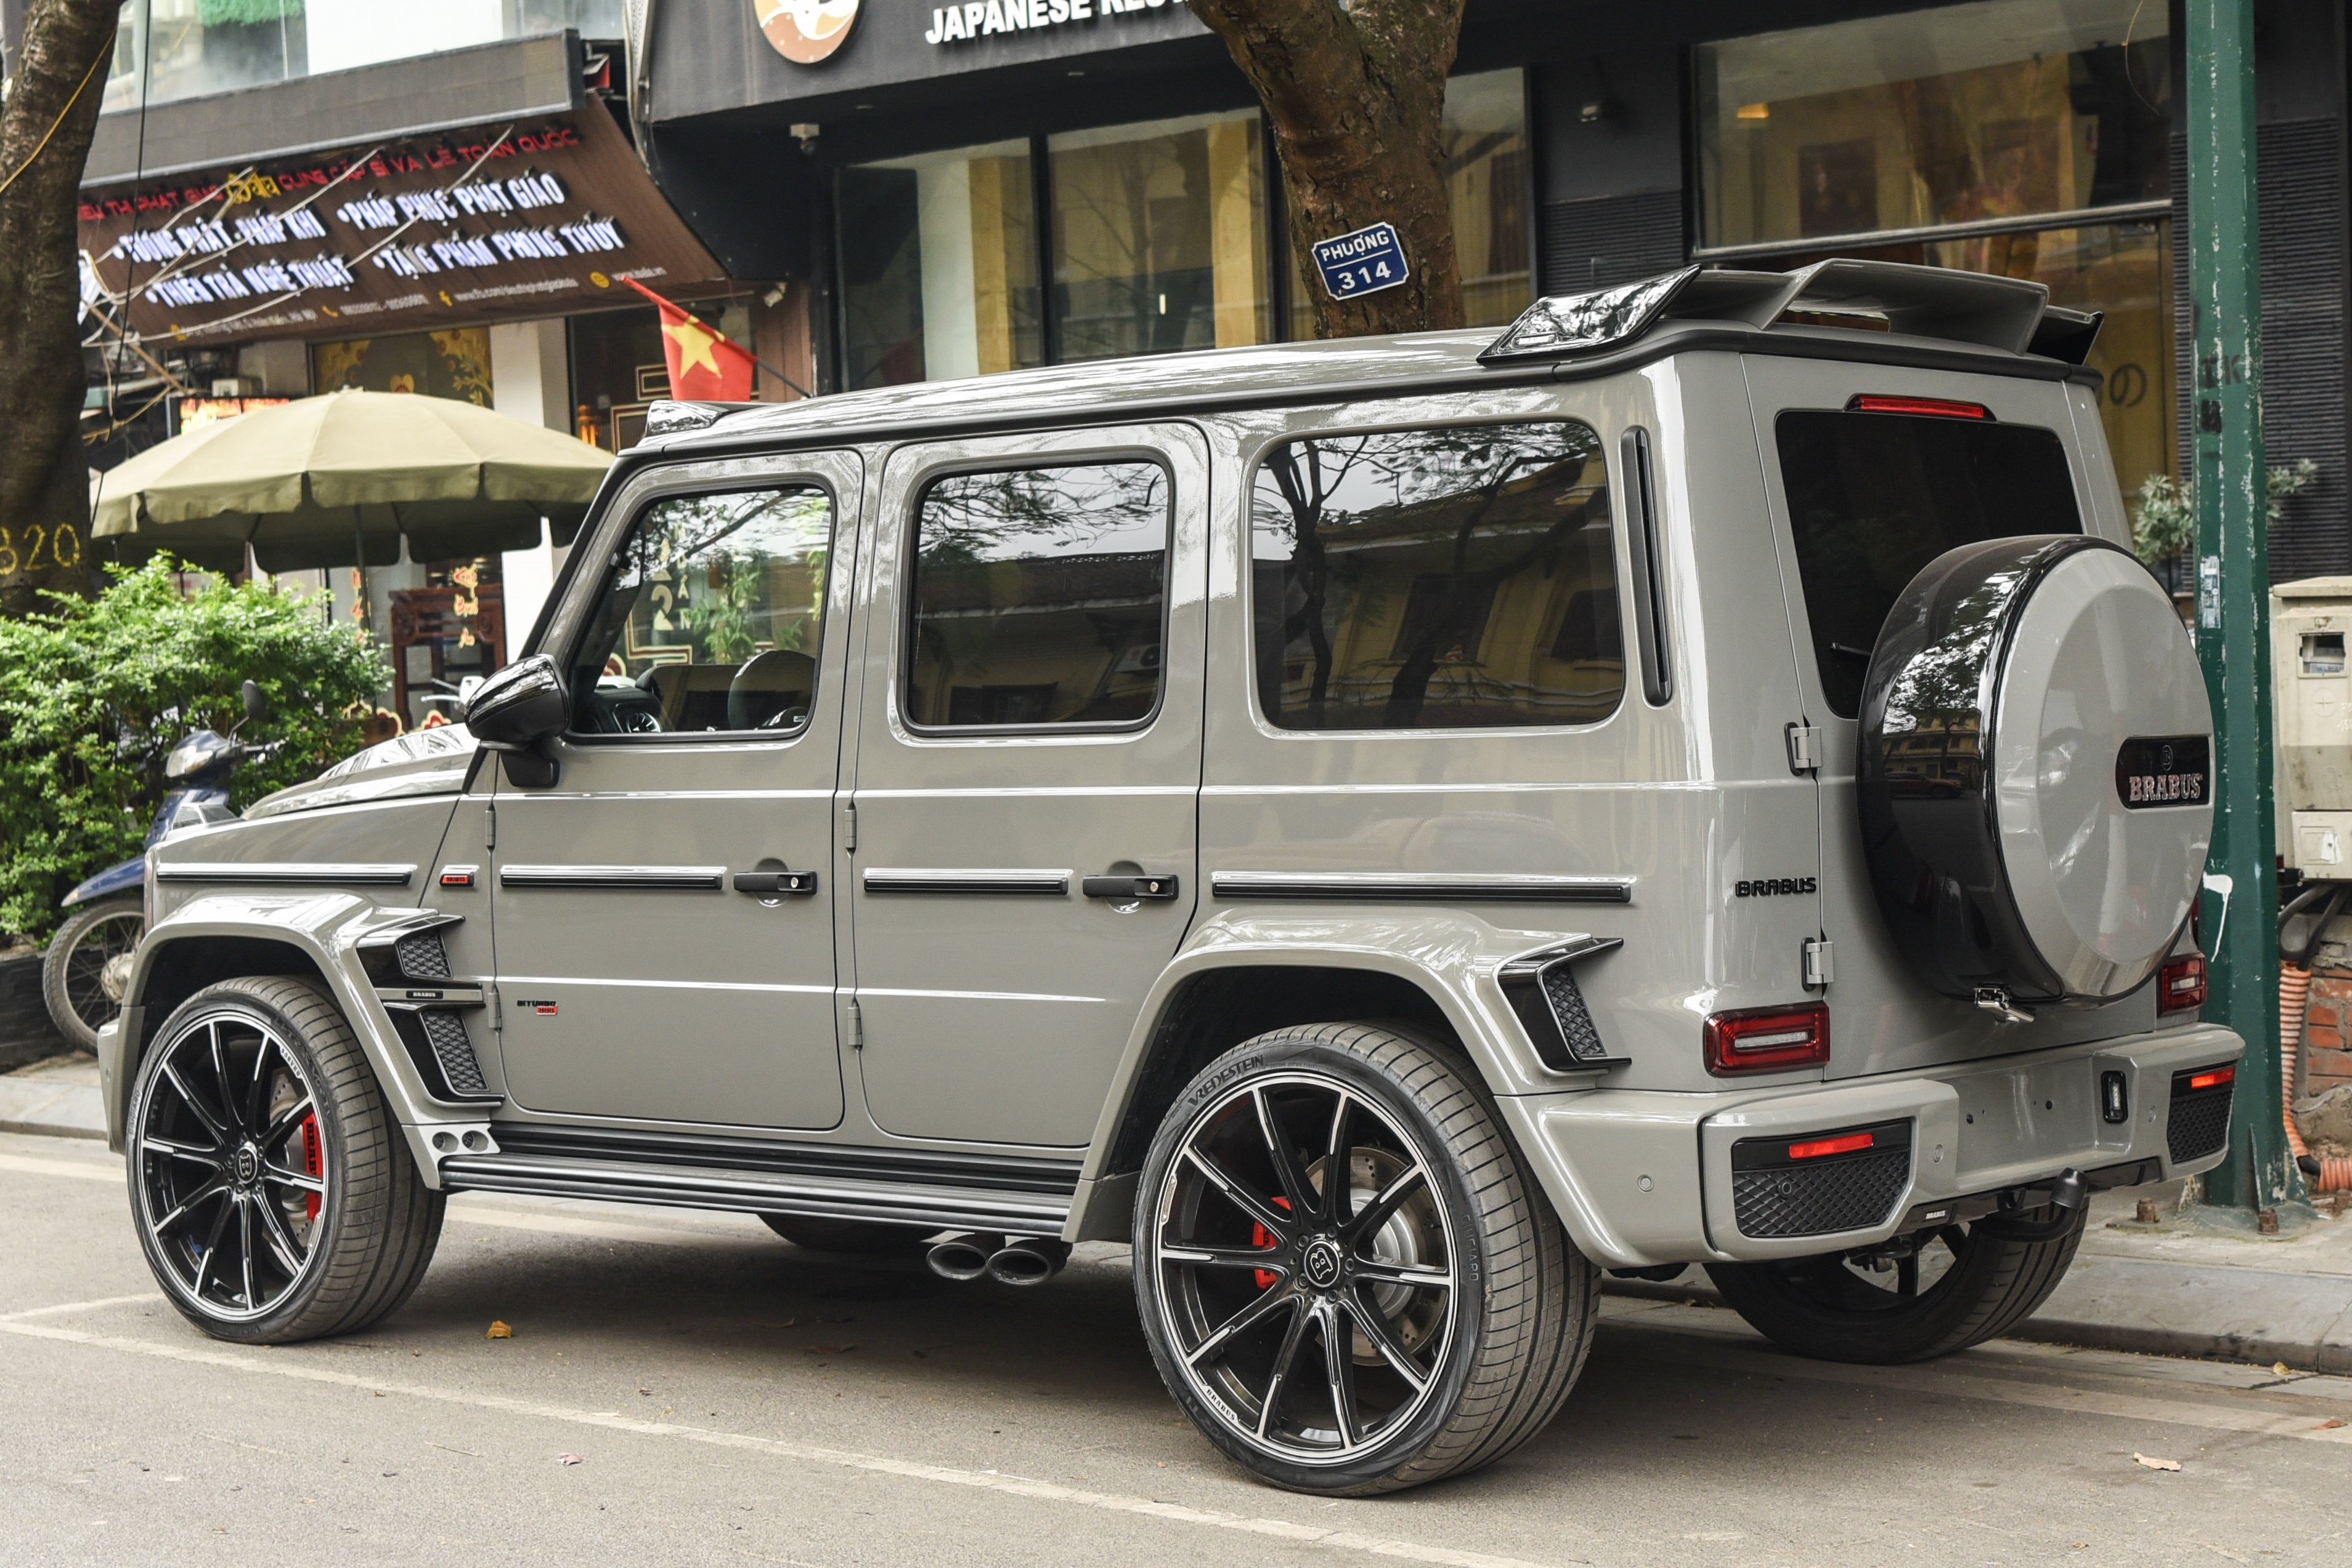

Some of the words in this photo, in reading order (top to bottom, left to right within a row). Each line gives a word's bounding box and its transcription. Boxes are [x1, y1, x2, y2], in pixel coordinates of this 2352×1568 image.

[925, 0, 1091, 44] JAPANESE
[1338, 261, 1391, 290] 314
[2130, 773, 2203, 802] BRABUS
[1735, 877, 1817, 898] BRABUS
[281, 1047, 301, 1077] BRABUS
[1187, 1054, 1264, 1107] VREDESTEIN
[306, 1122, 317, 1175] BRAB
[1206, 1388, 1236, 1421] BRABUS
